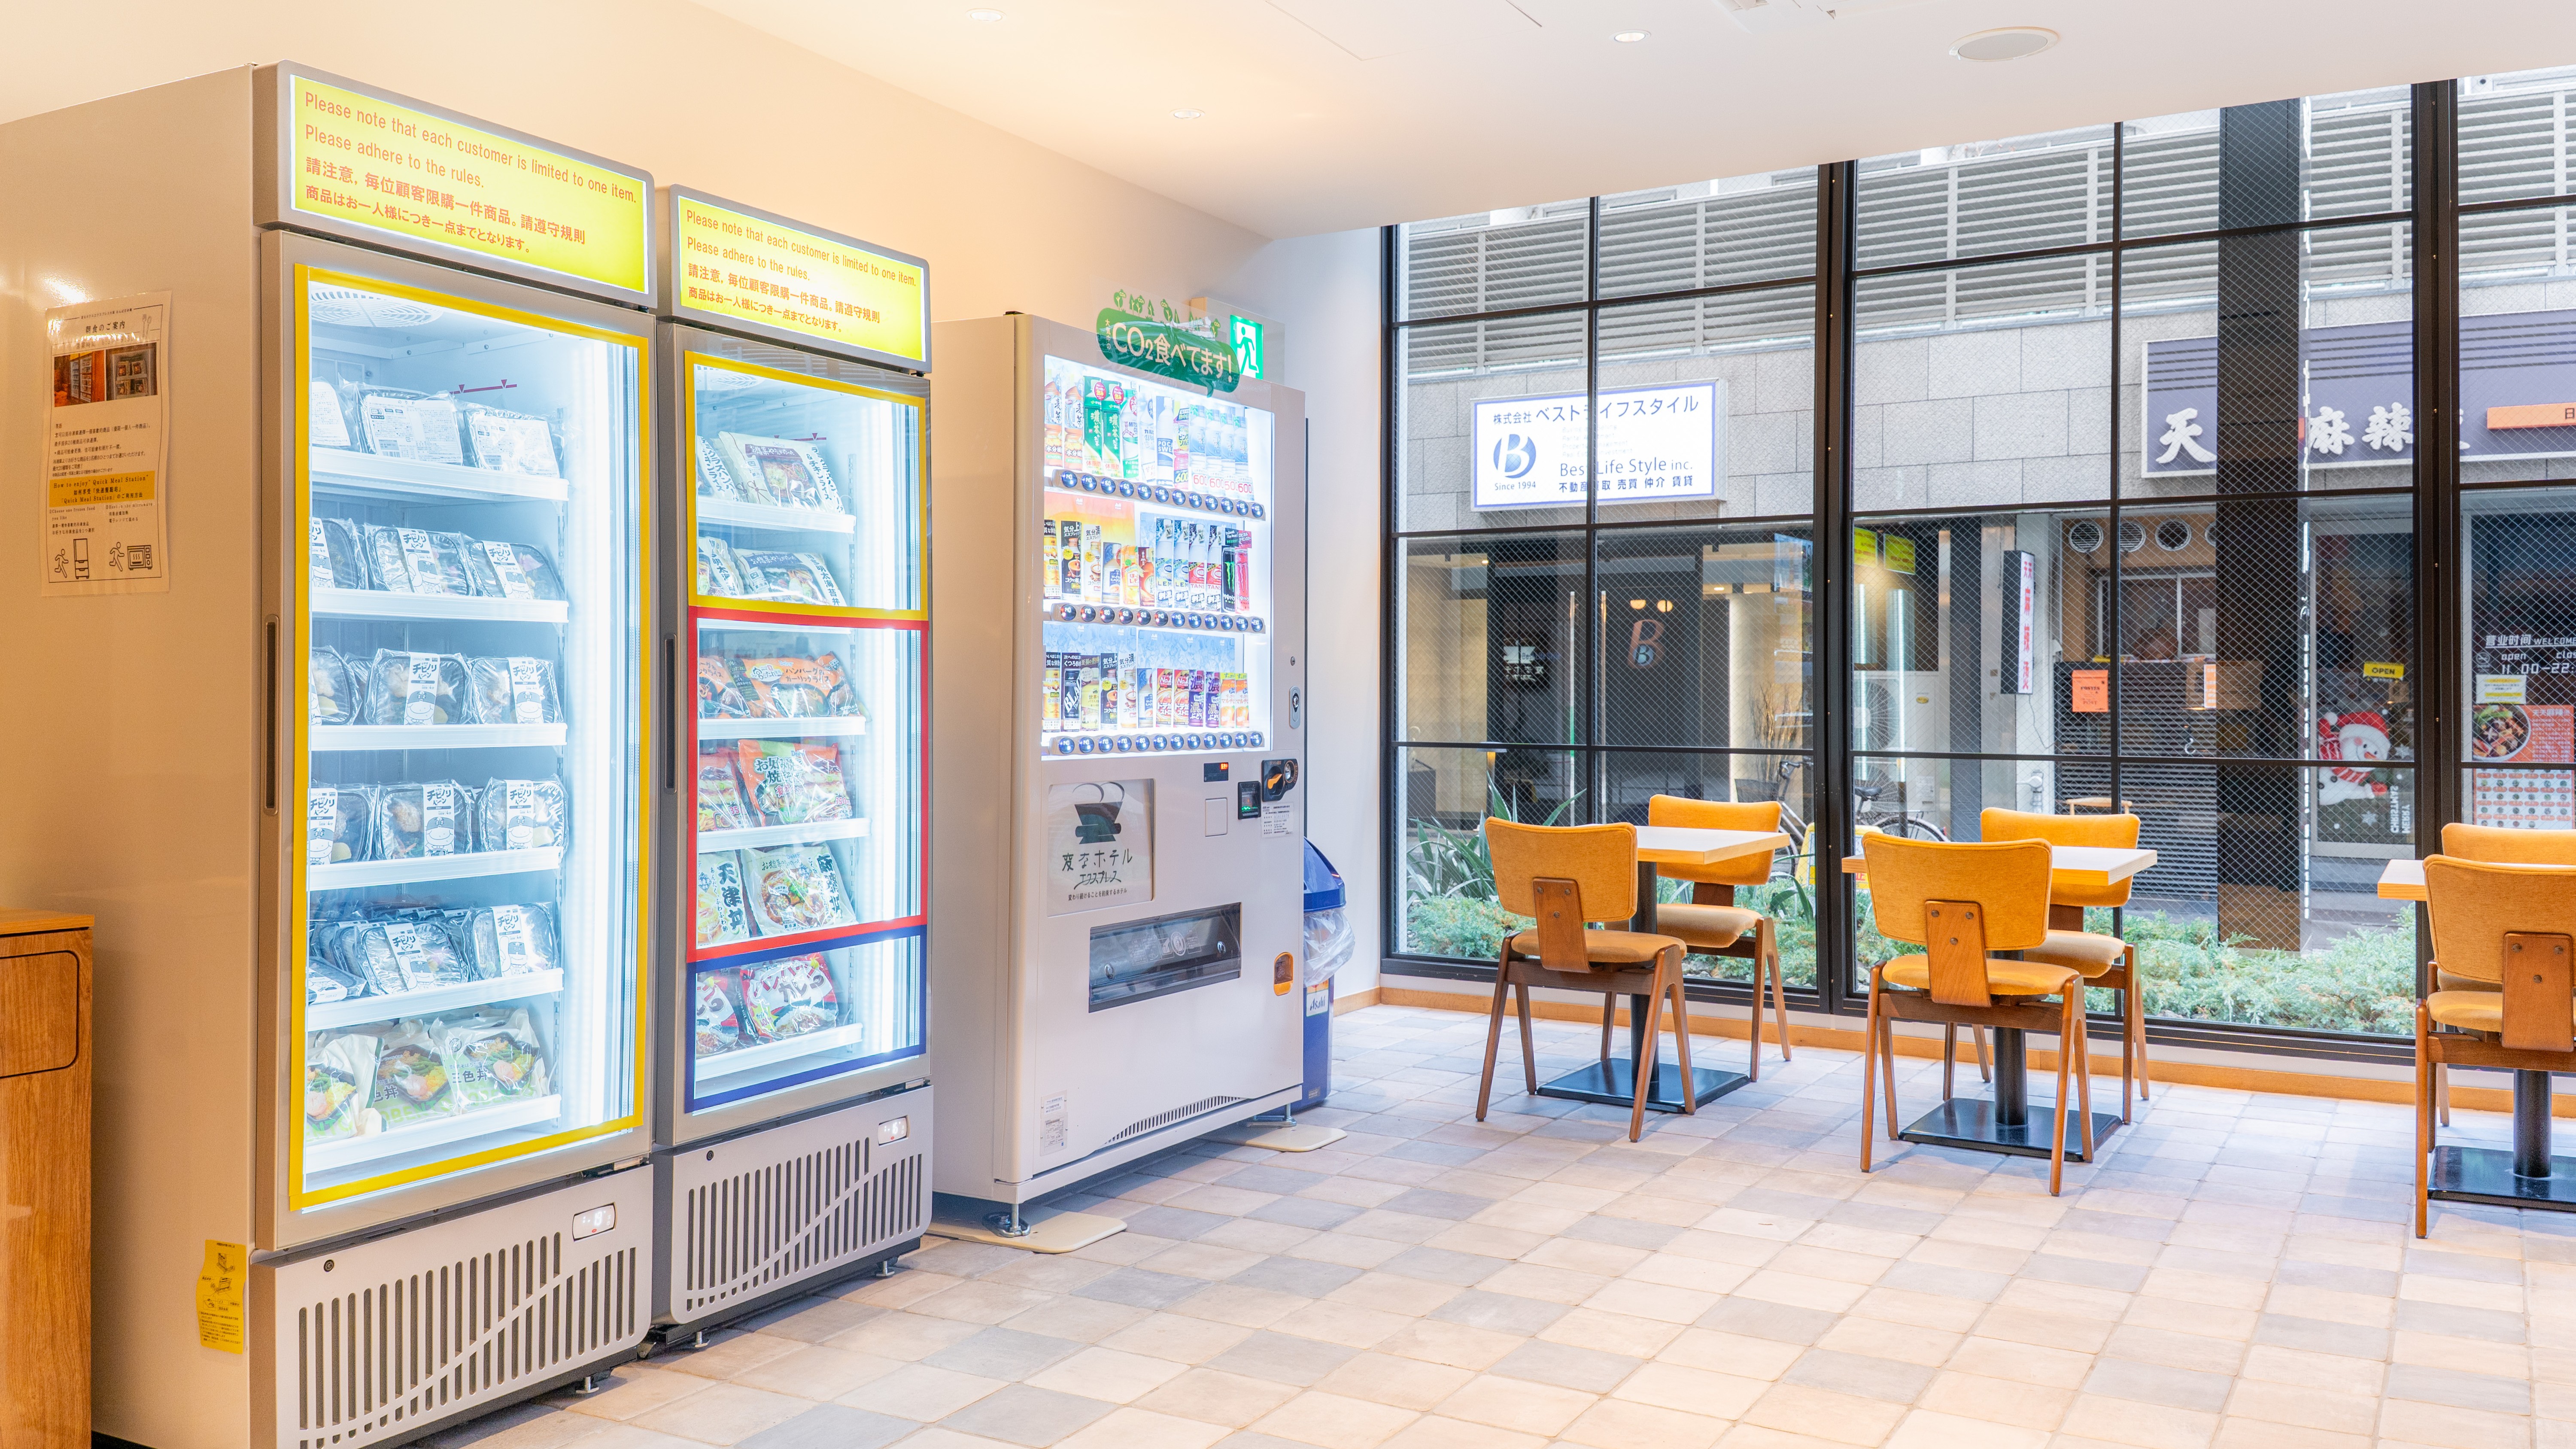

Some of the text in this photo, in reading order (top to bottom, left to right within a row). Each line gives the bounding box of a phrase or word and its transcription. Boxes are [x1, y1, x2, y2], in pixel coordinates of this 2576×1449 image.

[306, 91, 636, 203] Please note that each customer is limited to one item.
[306, 124, 484, 188] Please adhere to the rules.
[306, 185, 530, 253] 商品はお一人様につき一点までとなります。
[687, 210, 916, 287] Please note that each customer is limited to one item.
[687, 237, 810, 281] Please adhere to the rules.
[689, 286, 842, 333] 商品はお一人様につき一点までとなります。
[1493, 395, 1699, 425] 株式会社 ベストイフスタイル
[1597, 459, 1623, 474] Life
[1629, 457, 1666, 475] Style
[1671, 459, 1692, 471] inc.
[1238, 483, 1252, 494] 600
[1495, 483, 1514, 491] Since
[1617, 476, 1692, 489] 売買 仲介 賃貸
[2501, 653, 2526, 662] open
[1062, 848, 1133, 872] 変なホテル
[1074, 871, 1121, 890] エクスプレス
[718, 863, 743, 930] 天津丼
[1068, 888, 1127, 901] 変わり続けることを約束するホテル
[1310, 995, 1326, 1011] Asahi
